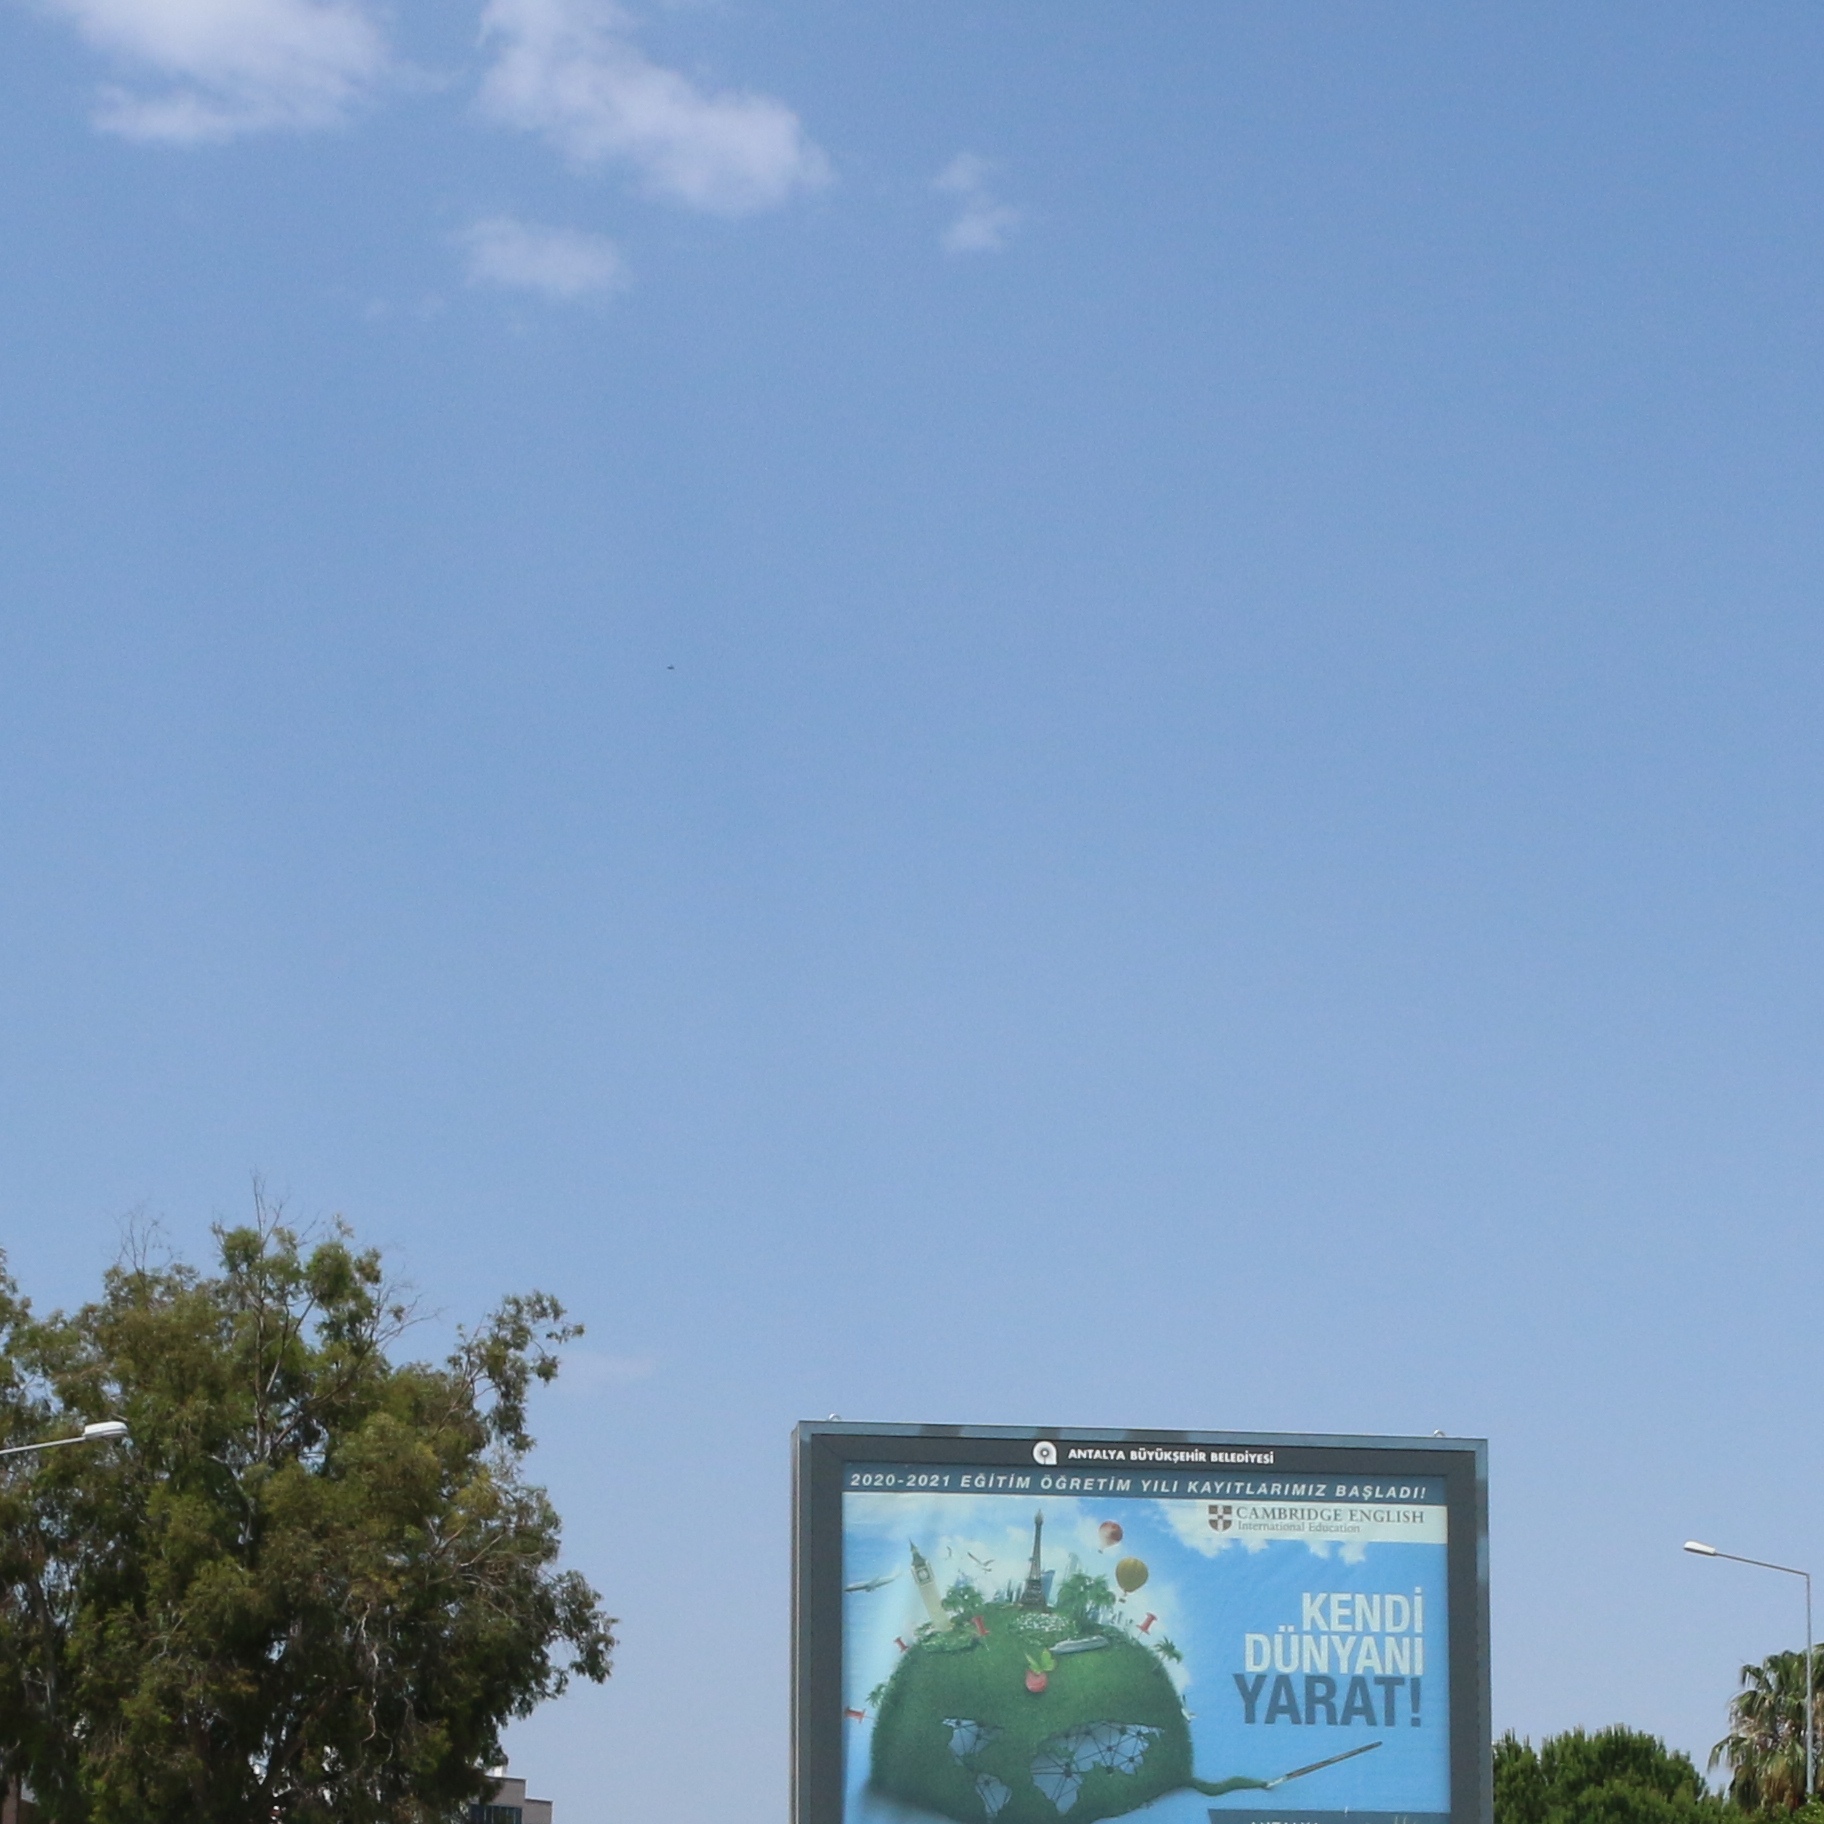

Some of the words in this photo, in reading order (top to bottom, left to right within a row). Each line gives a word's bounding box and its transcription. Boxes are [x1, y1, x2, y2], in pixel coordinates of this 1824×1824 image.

[1068, 1449, 1125, 1460] ANTALYA
[1130, 1447, 1207, 1464] BÜYÜKŞEHİR
[1210, 1449, 1274, 1464] BELEDİYESİ
[850, 1473, 951, 1487] 2020-2021
[960, 1472, 1031, 1488] EĞİTİM
[1040, 1473, 1131, 1491] ÖĞRETİM
[1141, 1479, 1178, 1492] YILI
[1187, 1480, 1327, 1497] KAYITLARIMIZ
[1335, 1485, 1426, 1500] BAŞLADI!
[1236, 1506, 1343, 1521] CAMBRIDGE
[1349, 1509, 1424, 1524] ENGLISH
[1238, 1520, 1306, 1532] International
[1308, 1522, 1360, 1533] Education
[1302, 1586, 1423, 1633] KENDİ
[1245, 1625, 1424, 1675] DÜNYANI
[1232, 1673, 1421, 1727] YARAT!
